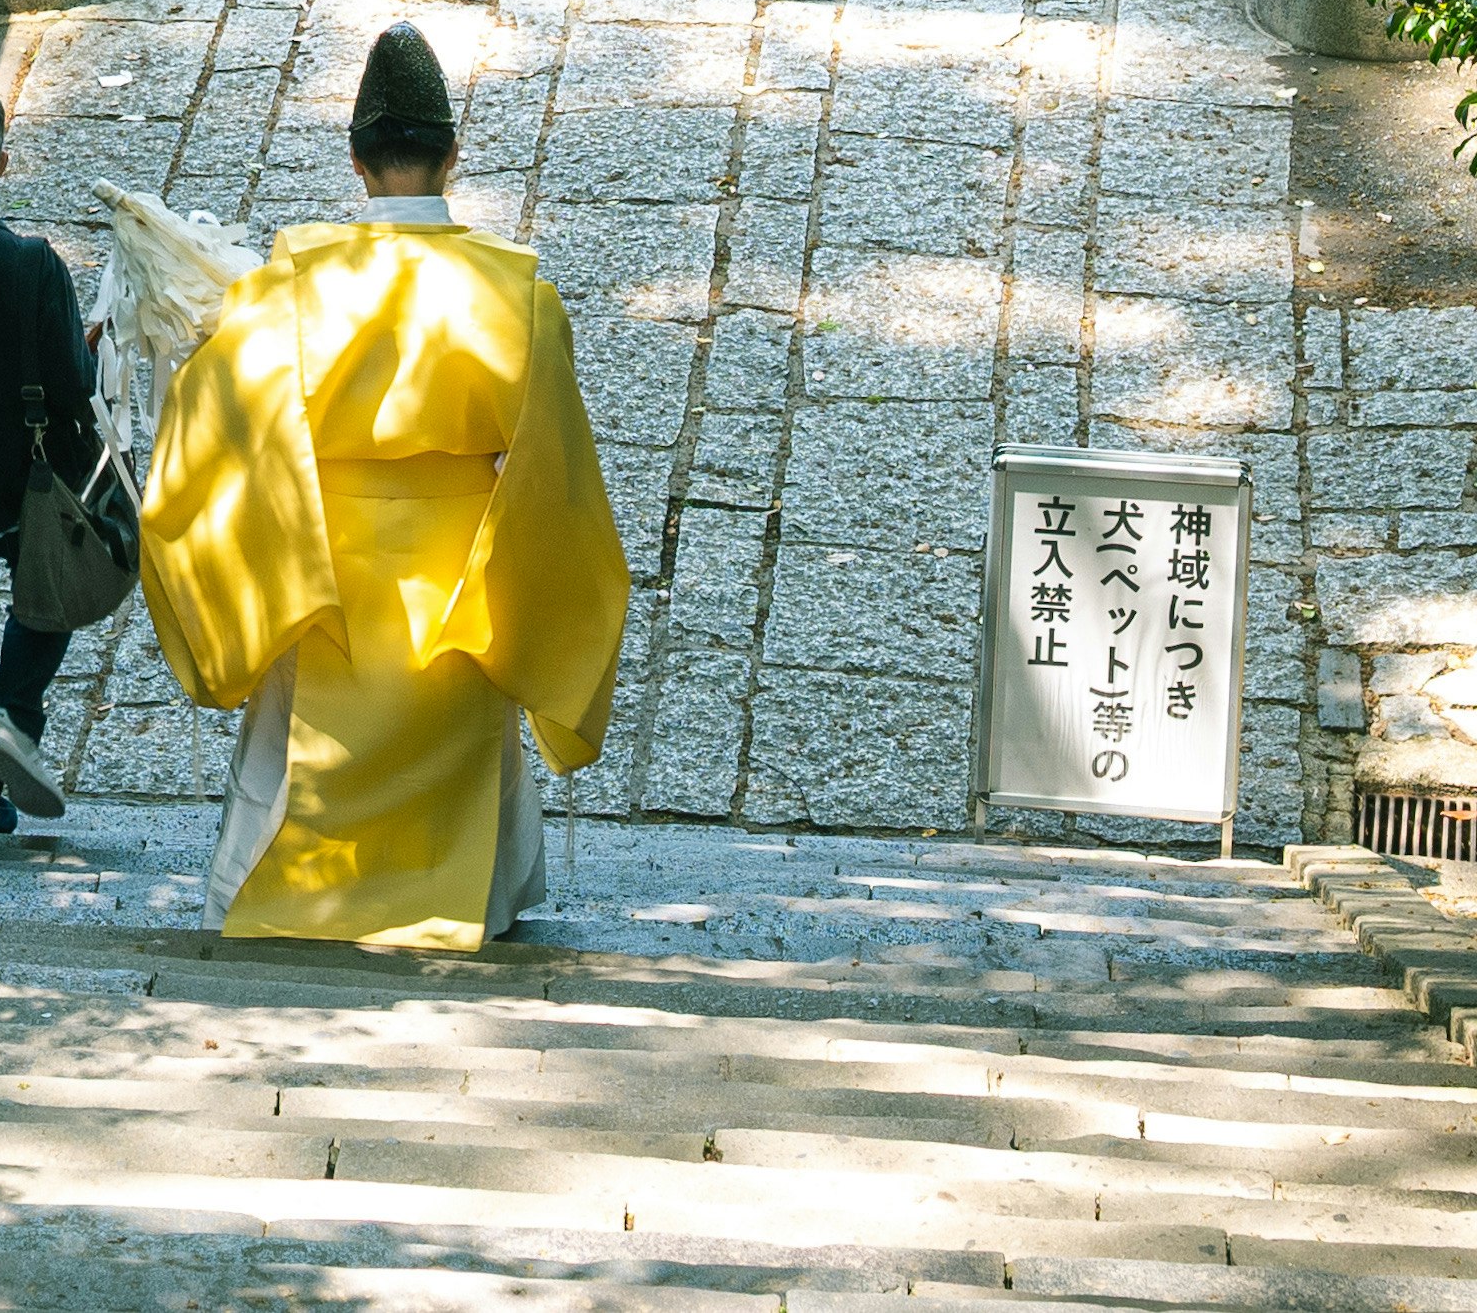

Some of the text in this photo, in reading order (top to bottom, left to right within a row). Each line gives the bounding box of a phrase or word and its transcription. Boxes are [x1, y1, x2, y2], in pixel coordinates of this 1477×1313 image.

[1027, 496, 1077, 667] 立入禁止
[1089, 500, 1145, 782] 犬（ペット）等の
[1165, 504, 1212, 720] 神域につき
